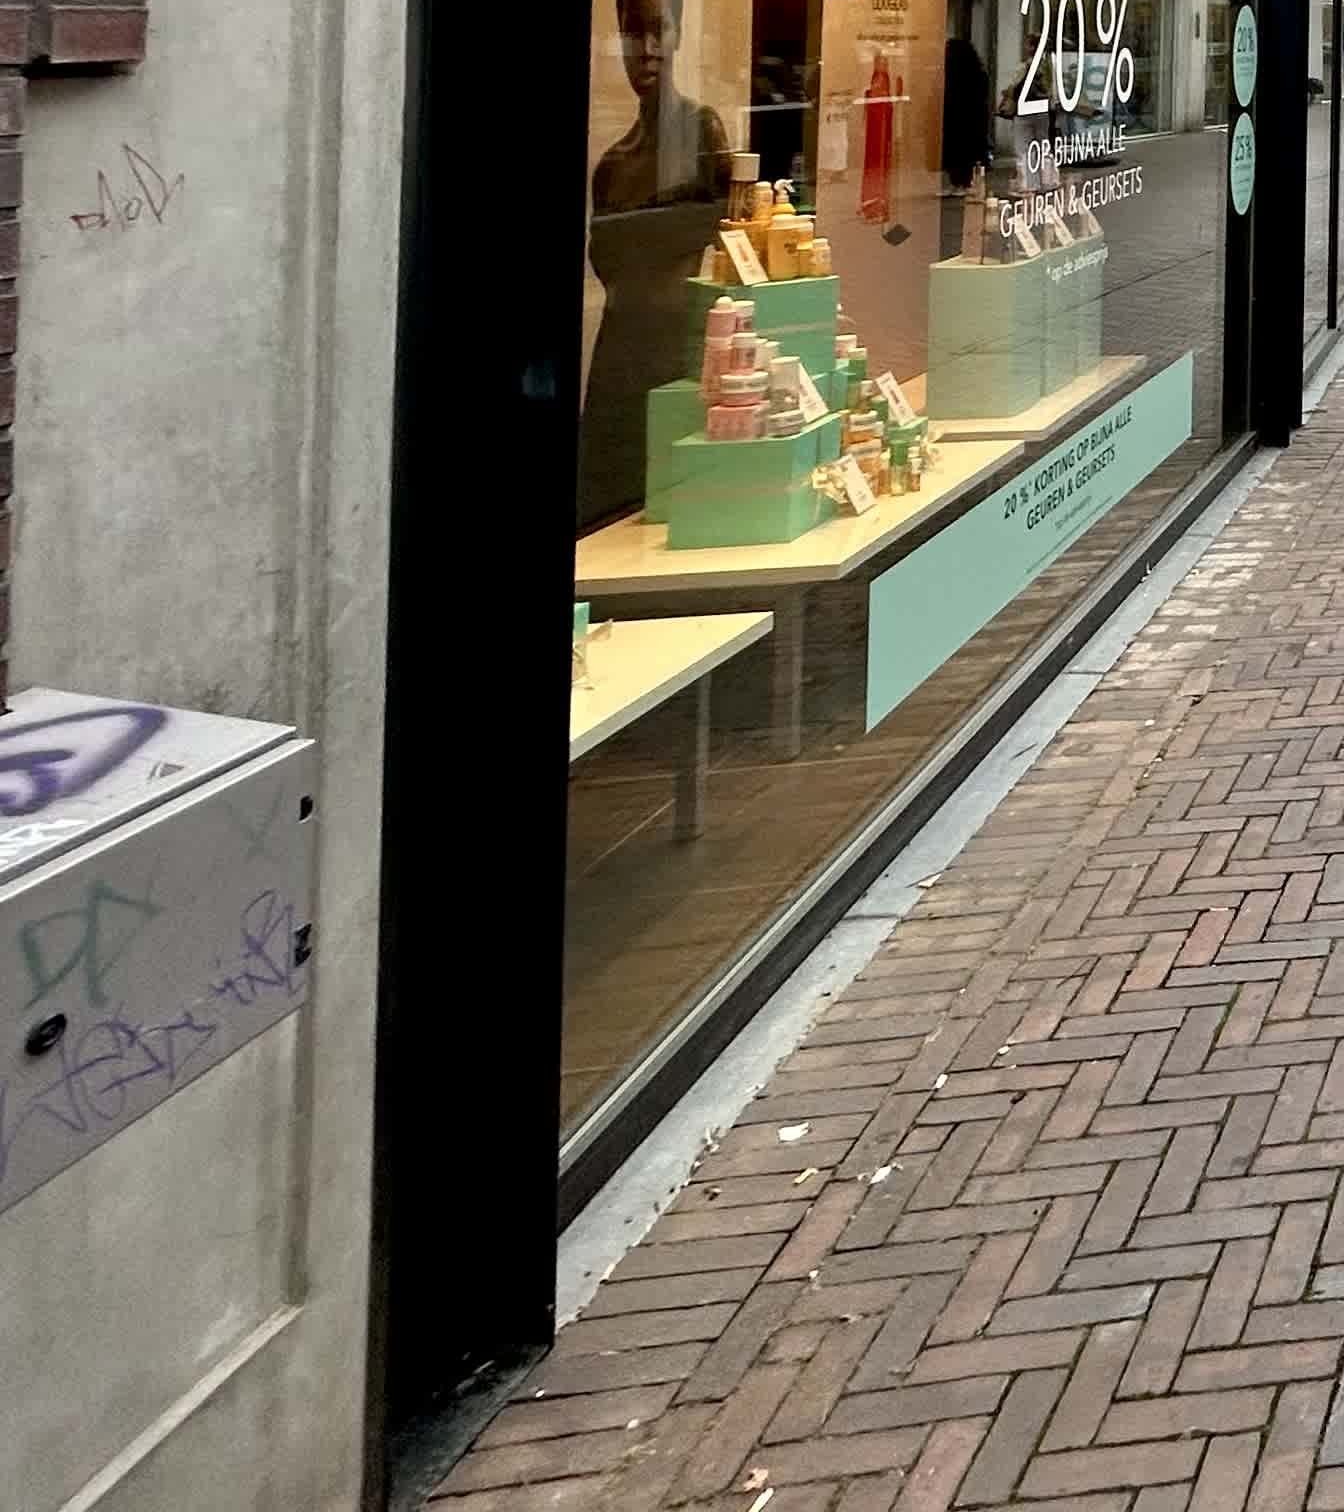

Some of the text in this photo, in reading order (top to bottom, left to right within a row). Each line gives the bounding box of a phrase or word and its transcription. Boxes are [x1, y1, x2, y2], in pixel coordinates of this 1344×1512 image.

[1028, 124, 1127, 173] OP BIJNA ALLE
[1000, 166, 1143, 238] GEUREN & GEURSETS
[1026, 487, 1066, 529] GEUREN
[1067, 478, 1073, 496] &
[1075, 445, 1116, 489] GEURSETS
[1034, 449, 1075, 496] KORTING
[1076, 438, 1090, 461] OP
[1090, 421, 1114, 450] BIJNA
[1114, 405, 1132, 433] ALLE
